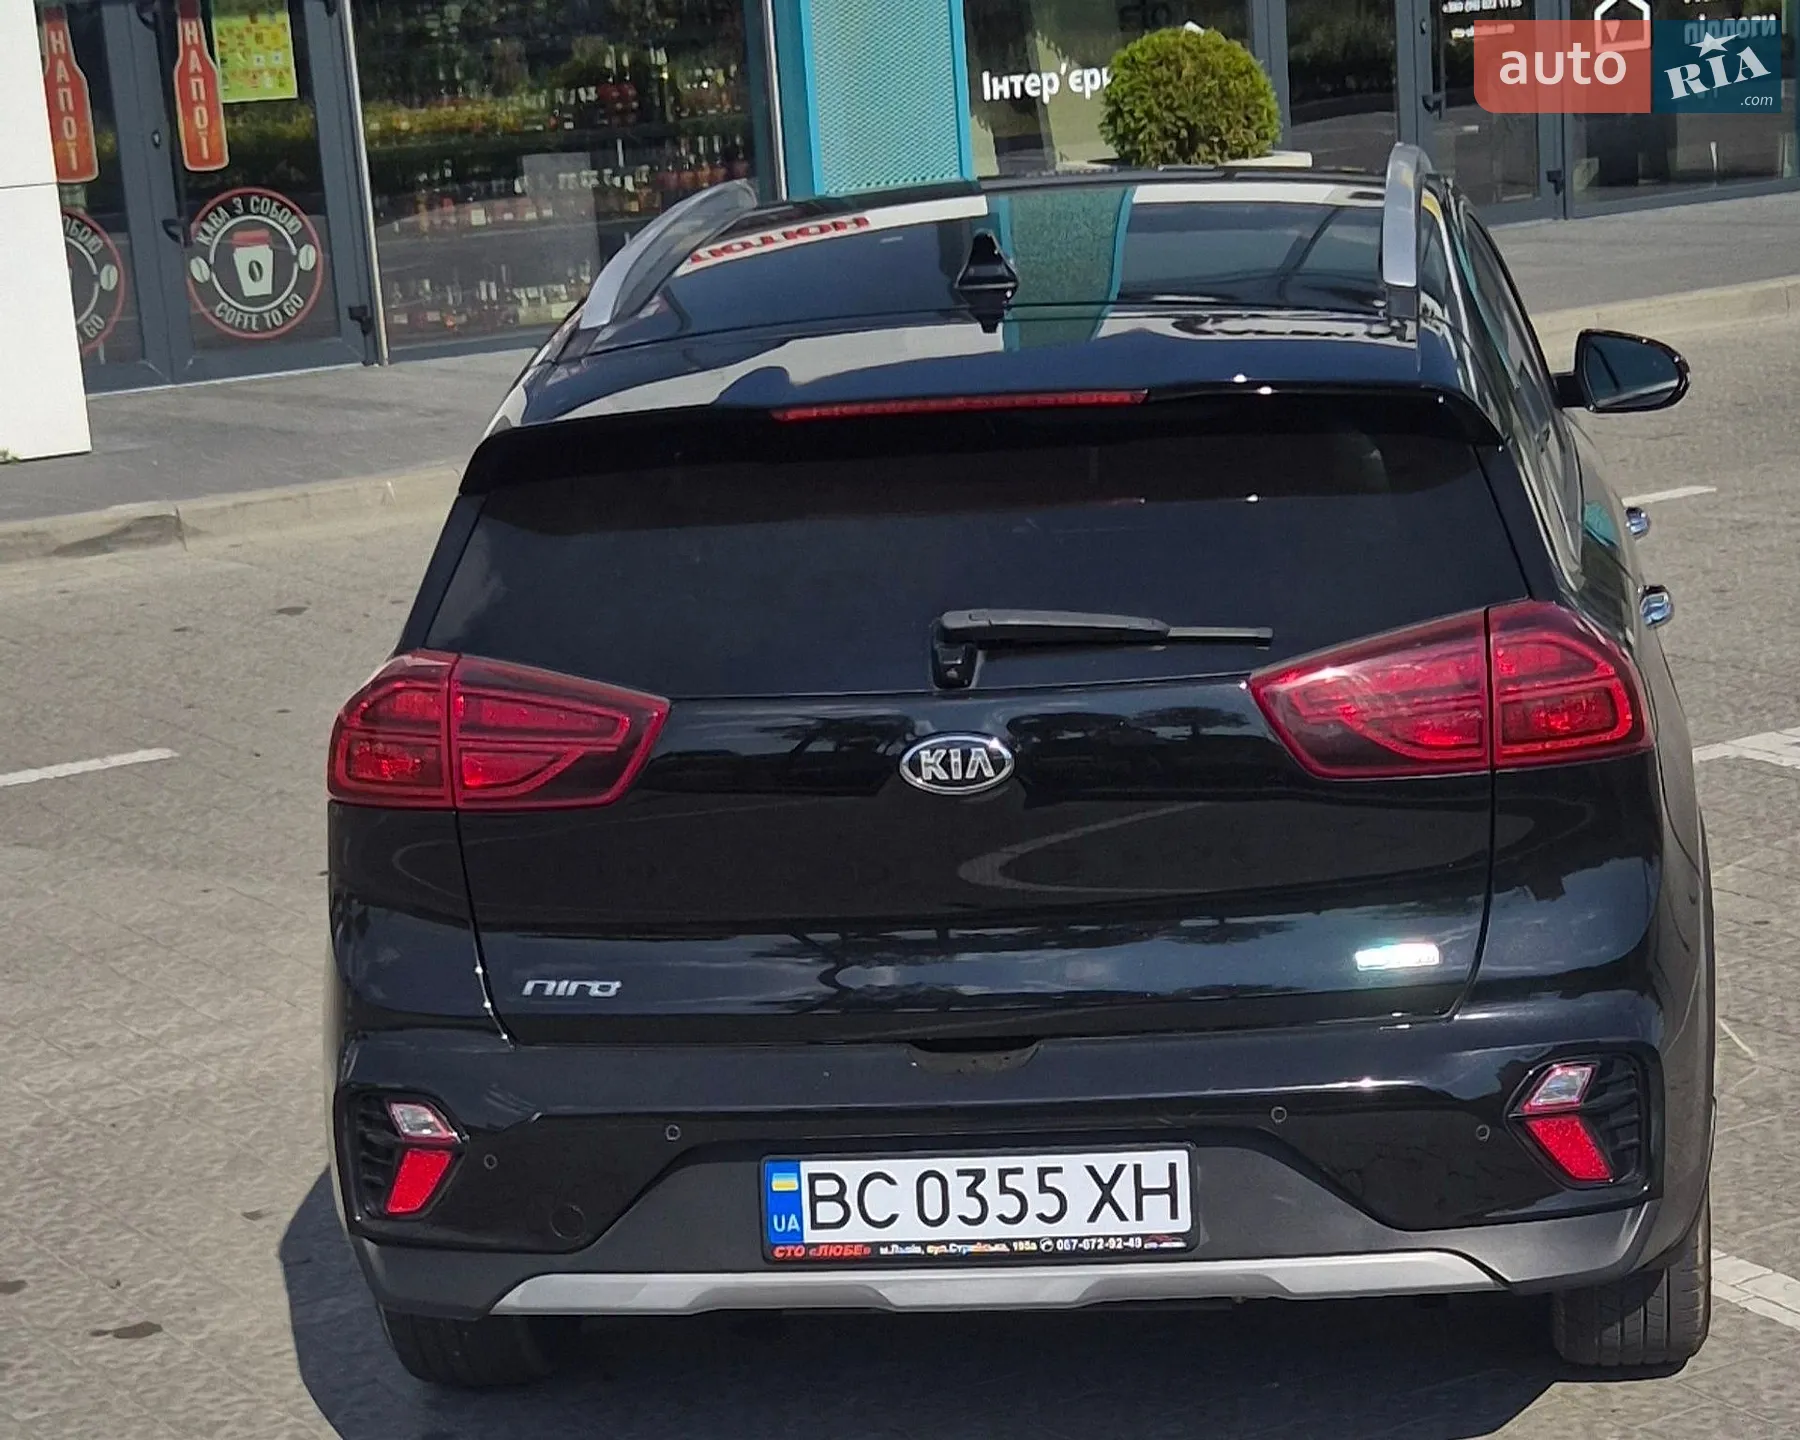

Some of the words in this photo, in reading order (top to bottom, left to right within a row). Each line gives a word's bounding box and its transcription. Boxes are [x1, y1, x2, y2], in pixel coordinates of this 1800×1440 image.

[50, 29, 79, 172] НАПОЇ
[184, 20, 210, 161] НАПОЇ
[196, 205, 231, 246] КАВА
[250, 196, 303, 235] СОБОЮ
[82, 313, 105, 338] GO
[214, 301, 260, 331] COFFE
[262, 307, 284, 329] TO
[283, 293, 305, 317] GO
[919, 746, 996, 781] KIA
[522, 979, 622, 997] niro
[807, 1170, 900, 1231] BC
[916, 1165, 1068, 1229] 0355
[1084, 1161, 1180, 1223] XH
[773, 1213, 801, 1233] UA
[773, 1244, 806, 1258] СТО
